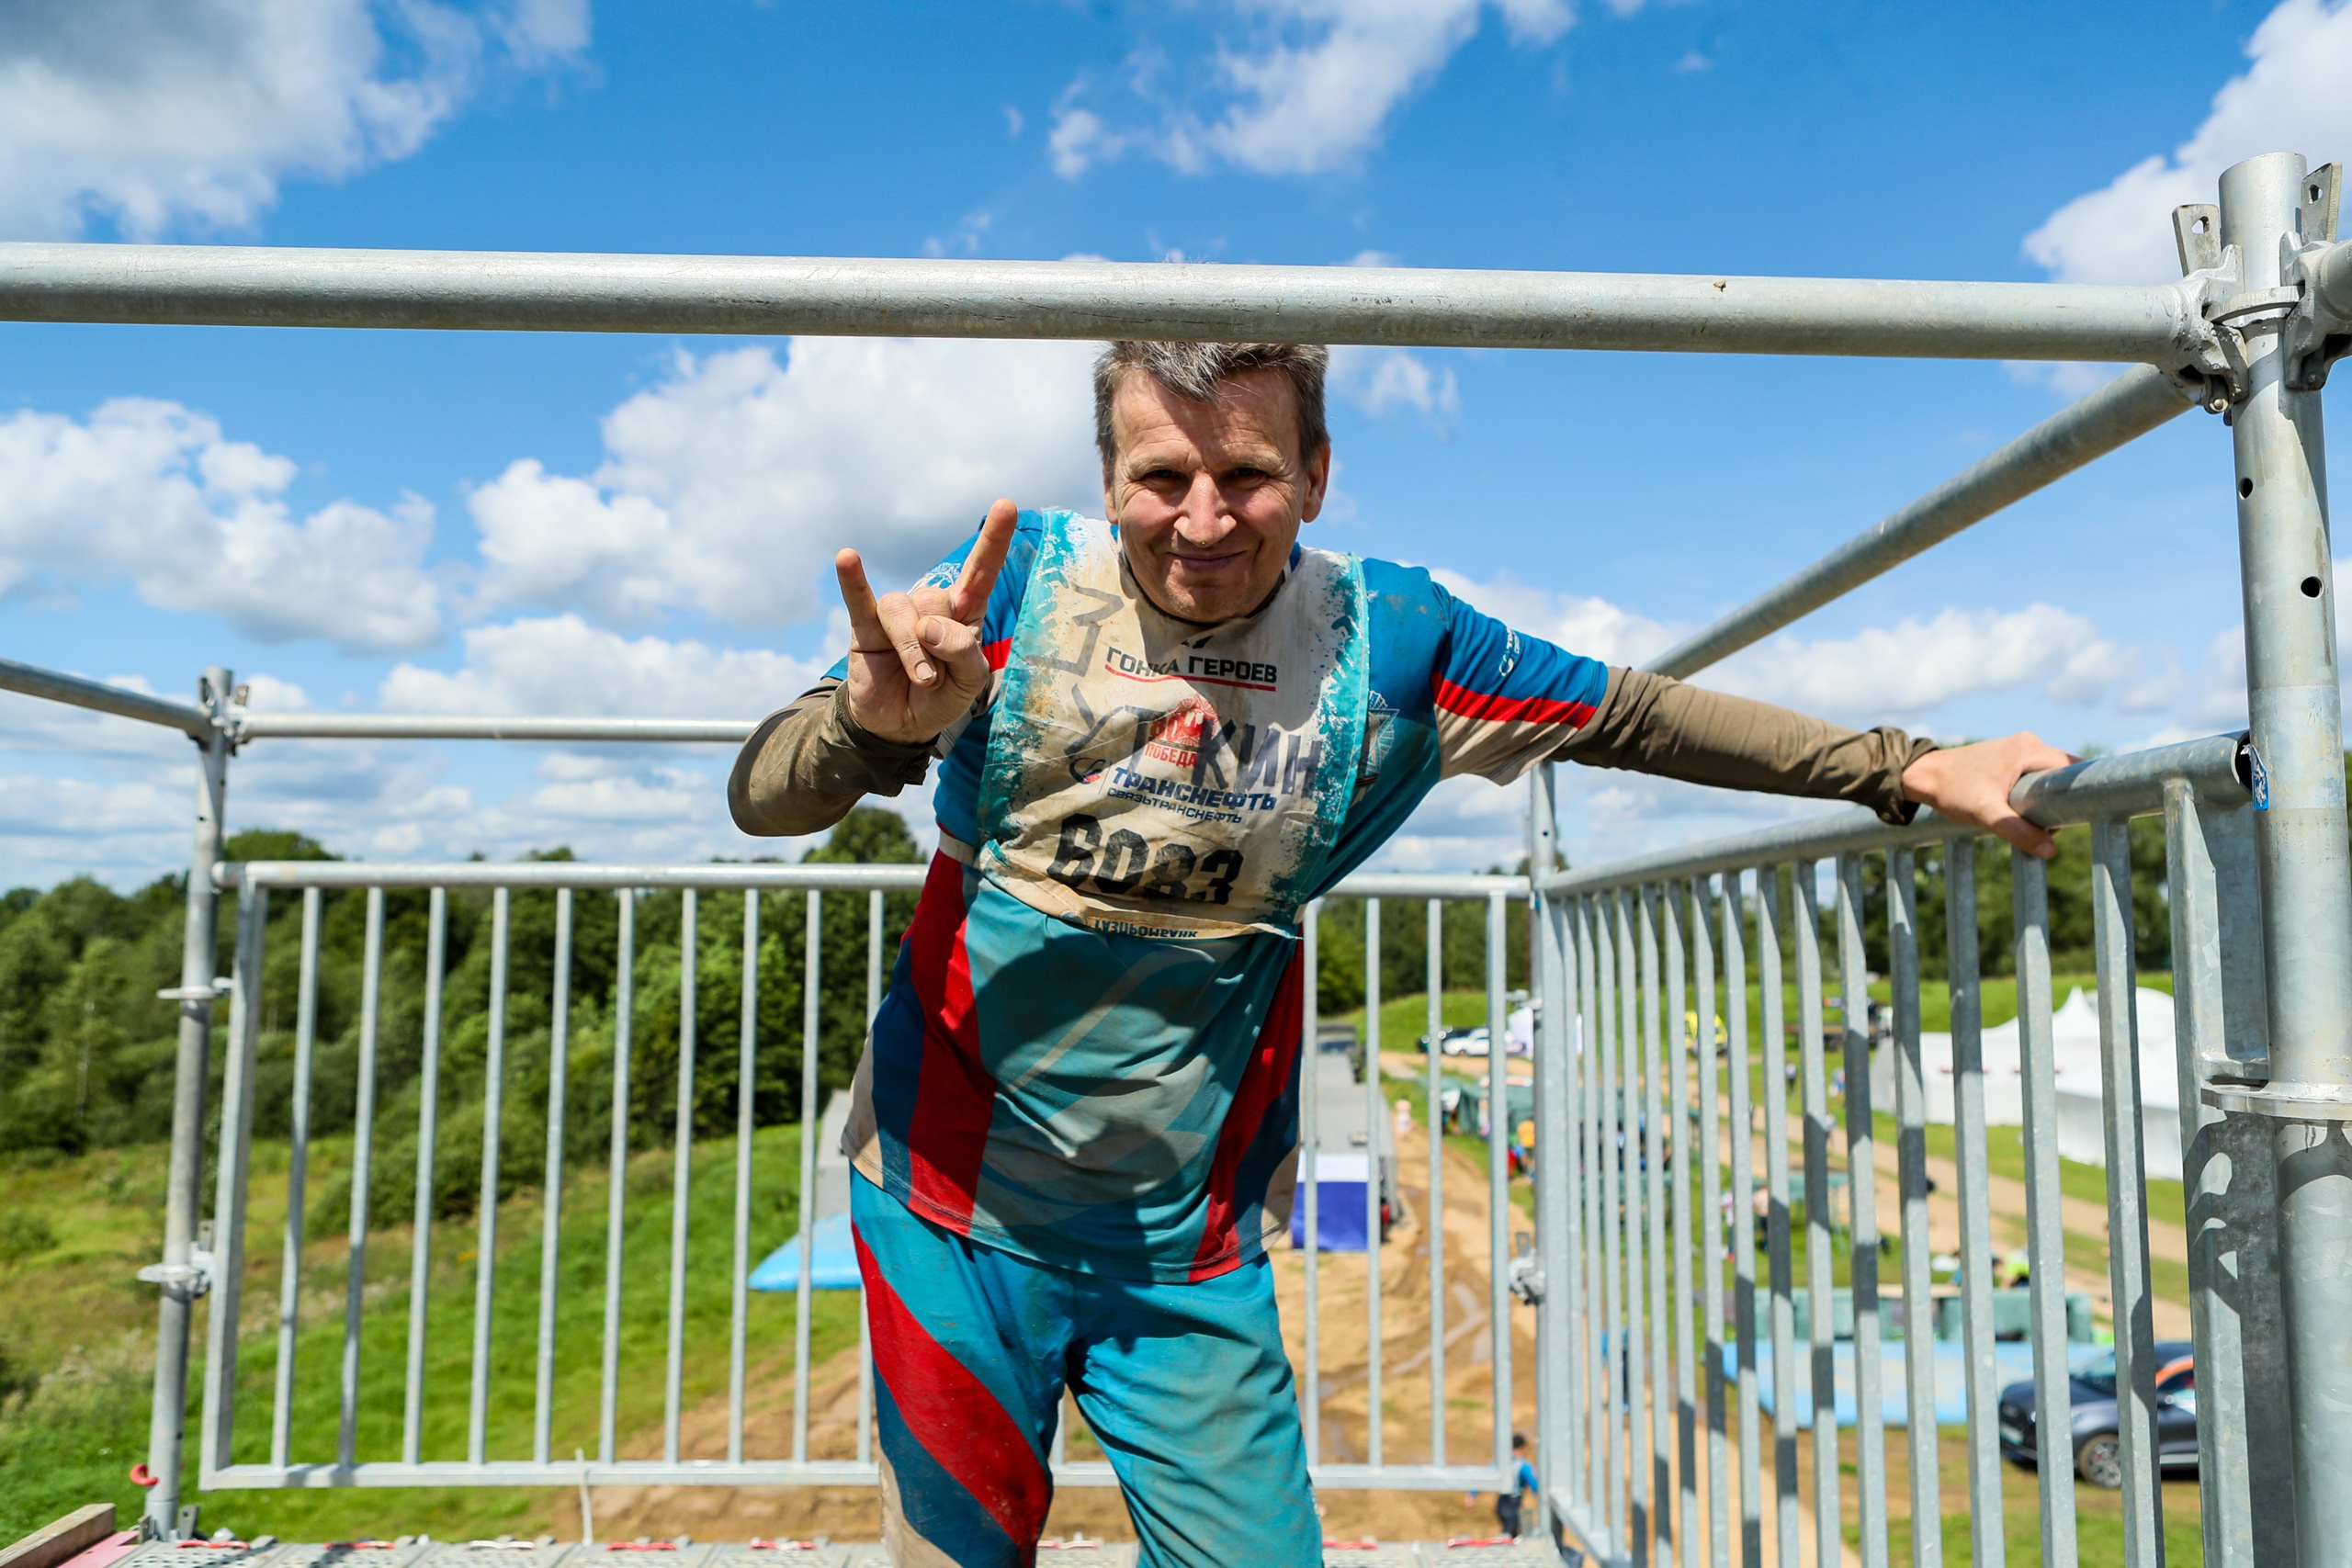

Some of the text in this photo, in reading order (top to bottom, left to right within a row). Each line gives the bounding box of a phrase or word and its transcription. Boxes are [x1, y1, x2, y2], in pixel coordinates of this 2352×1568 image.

[1106, 646, 1277, 683] ГОНКА ГЕРОЕВ
[1064, 682, 1323, 799] УТКИН
[1106, 787, 1242, 824] СВЯЗЬТРАНСНЕФТЬ
[1109, 766, 1278, 811] ТРАНСНЕФТЬ
[1046, 813, 1244, 905] 6083
